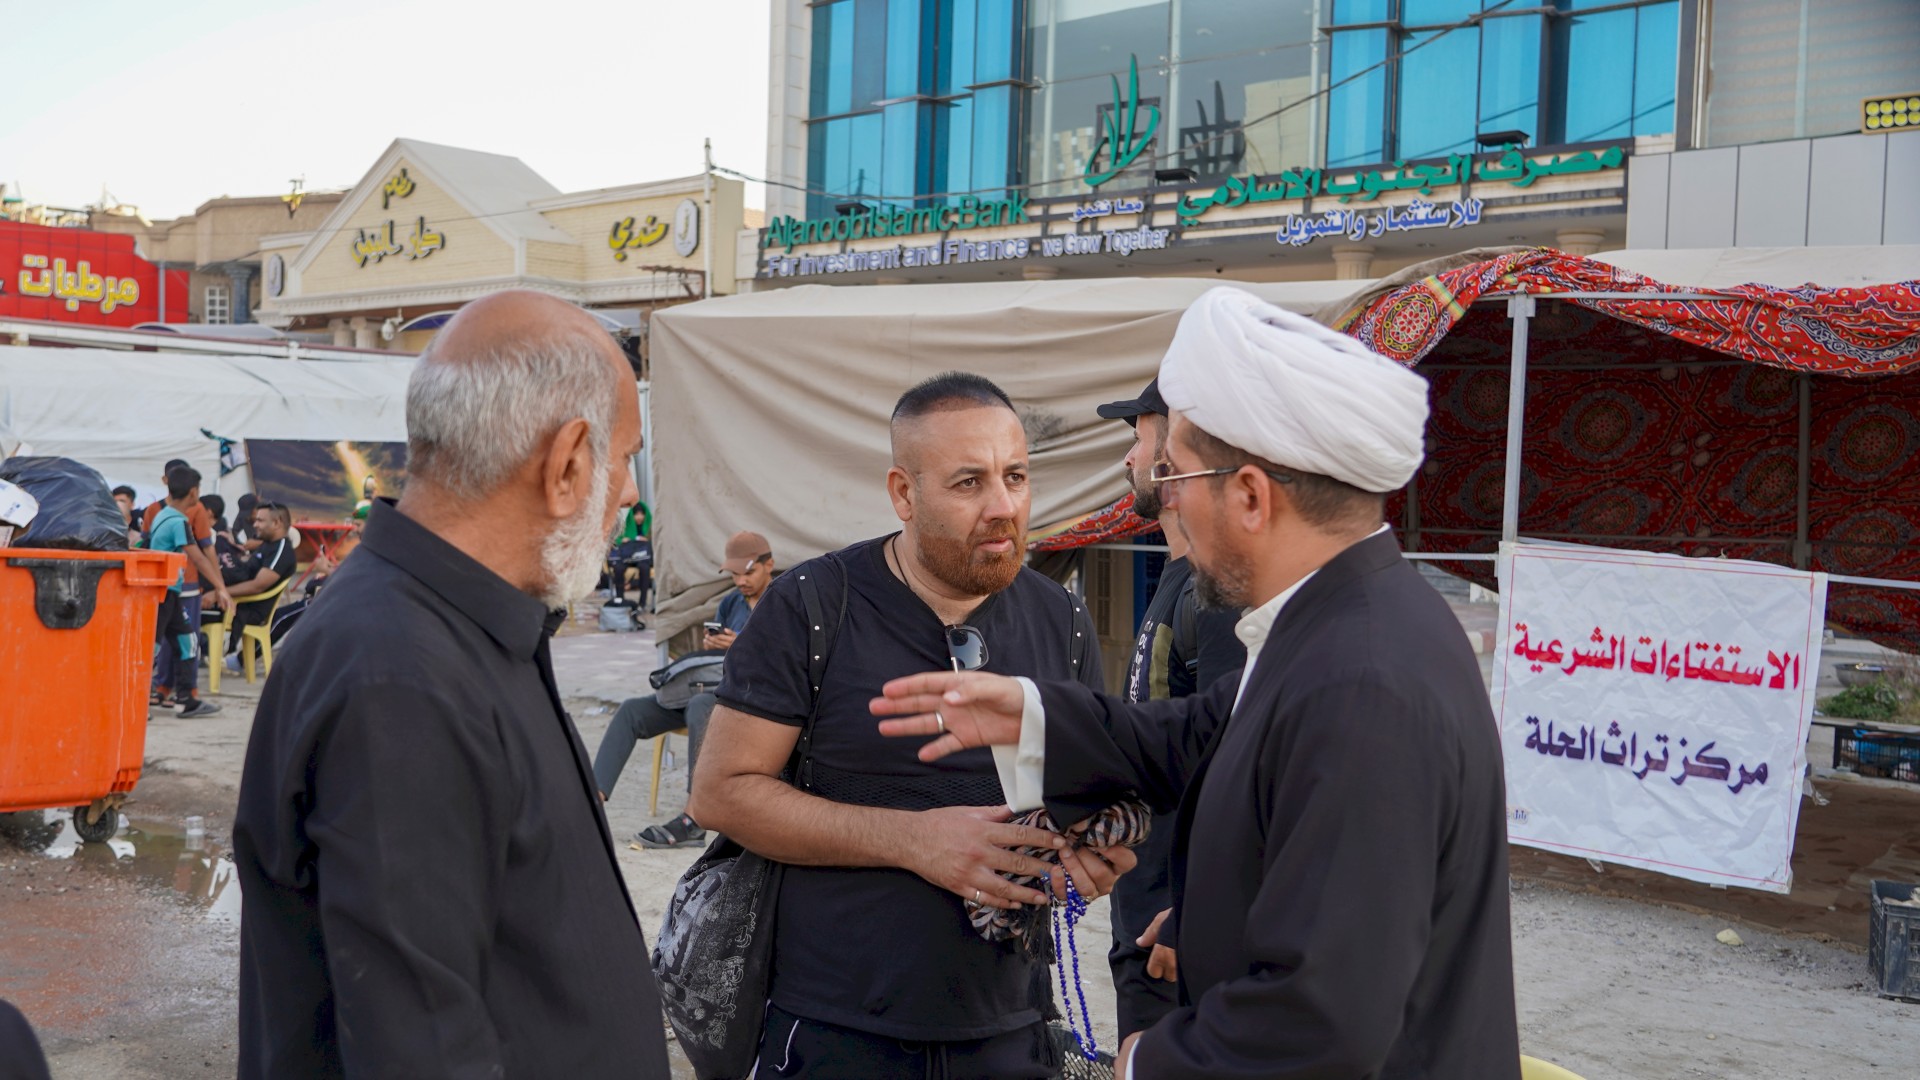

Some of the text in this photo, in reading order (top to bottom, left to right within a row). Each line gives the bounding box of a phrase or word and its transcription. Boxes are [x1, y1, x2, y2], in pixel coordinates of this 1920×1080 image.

[1177, 142, 1623, 226] مصرف الجنوب الاسلامي
[868, 202, 954, 238] Islamic
[957, 189, 1029, 230] Bank
[1064, 231, 1102, 255] Grow
[1103, 224, 1169, 256] Together
[1276, 197, 1484, 246] للاستثمار والتمويل
[19, 254, 139, 314] مرطبات
[768, 255, 798, 278] For
[901, 239, 940, 268] and
[1513, 622, 1800, 690] الاستفتاءات الشرعية
[1525, 715, 1769, 794] مركز تراث الحلة
